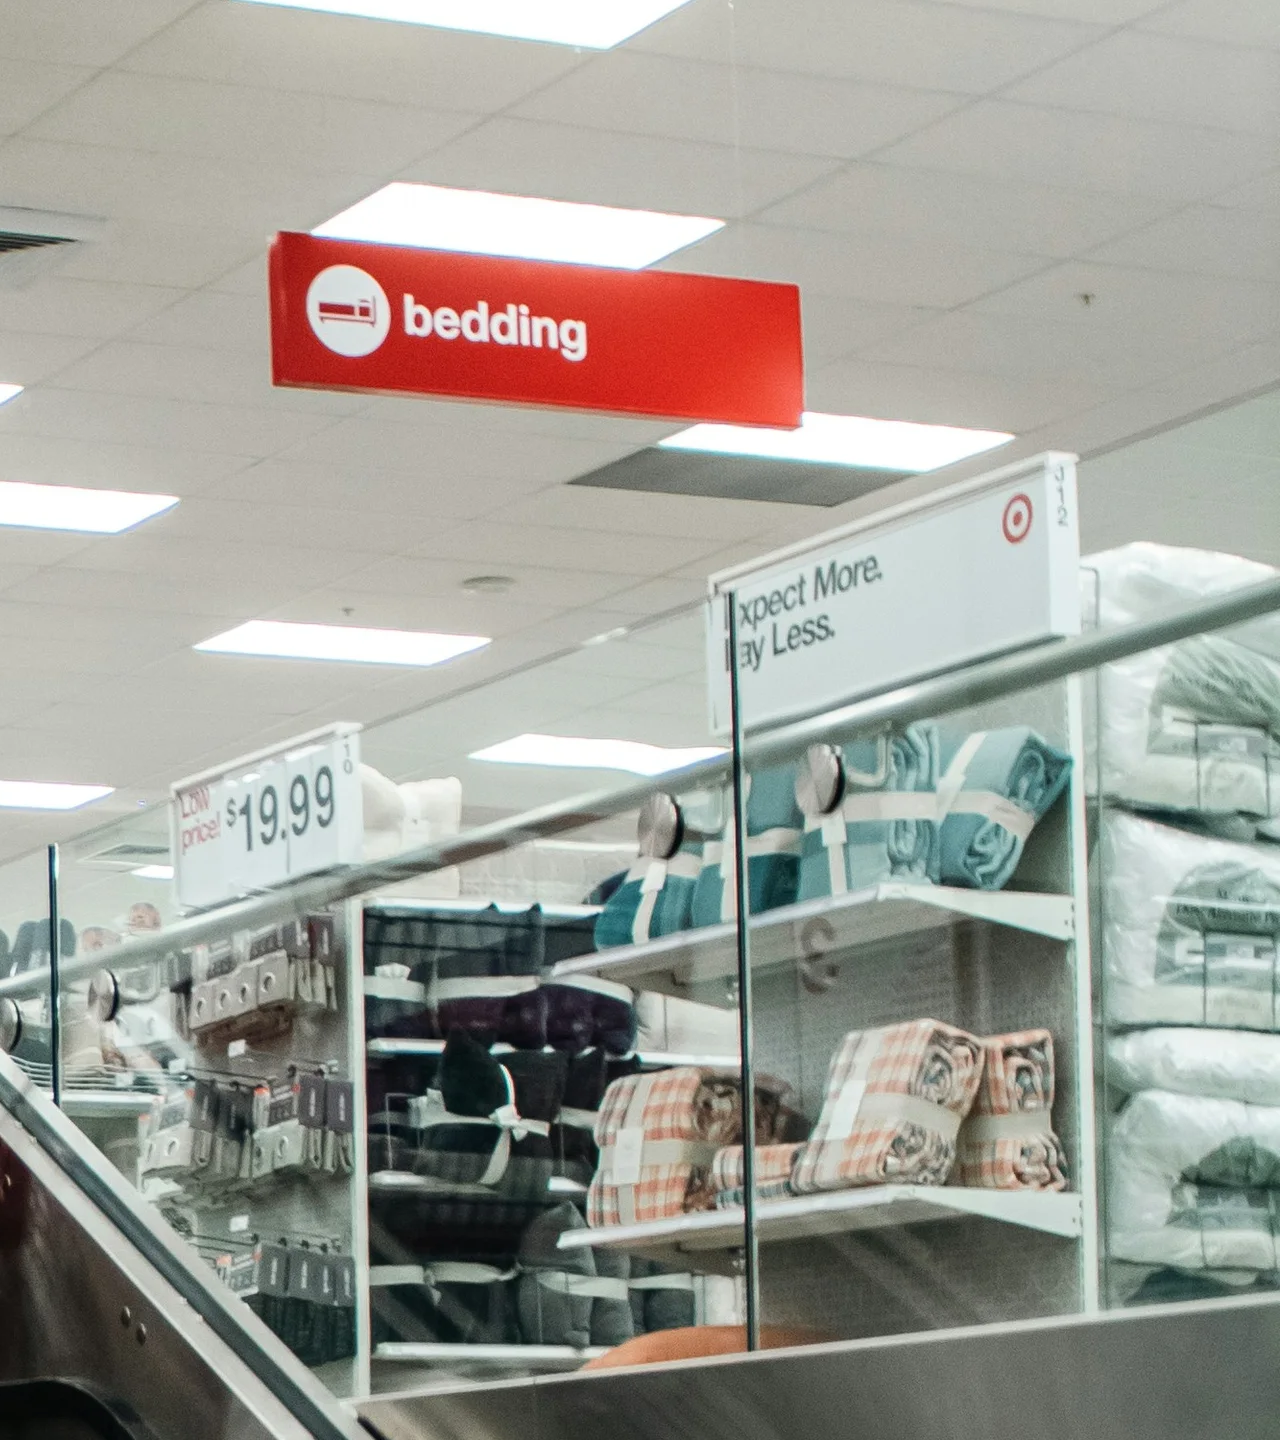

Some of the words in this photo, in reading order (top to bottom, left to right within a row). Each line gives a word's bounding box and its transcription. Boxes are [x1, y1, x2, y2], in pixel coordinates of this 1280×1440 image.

[403, 292, 588, 362] bedding
[724, 573, 807, 632] xpect
[813, 554, 883, 603] More.
[724, 634, 766, 674] ay
[771, 613, 836, 657] Less.
[182, 810, 221, 856] price!
[226, 765, 335, 852] $19.99
